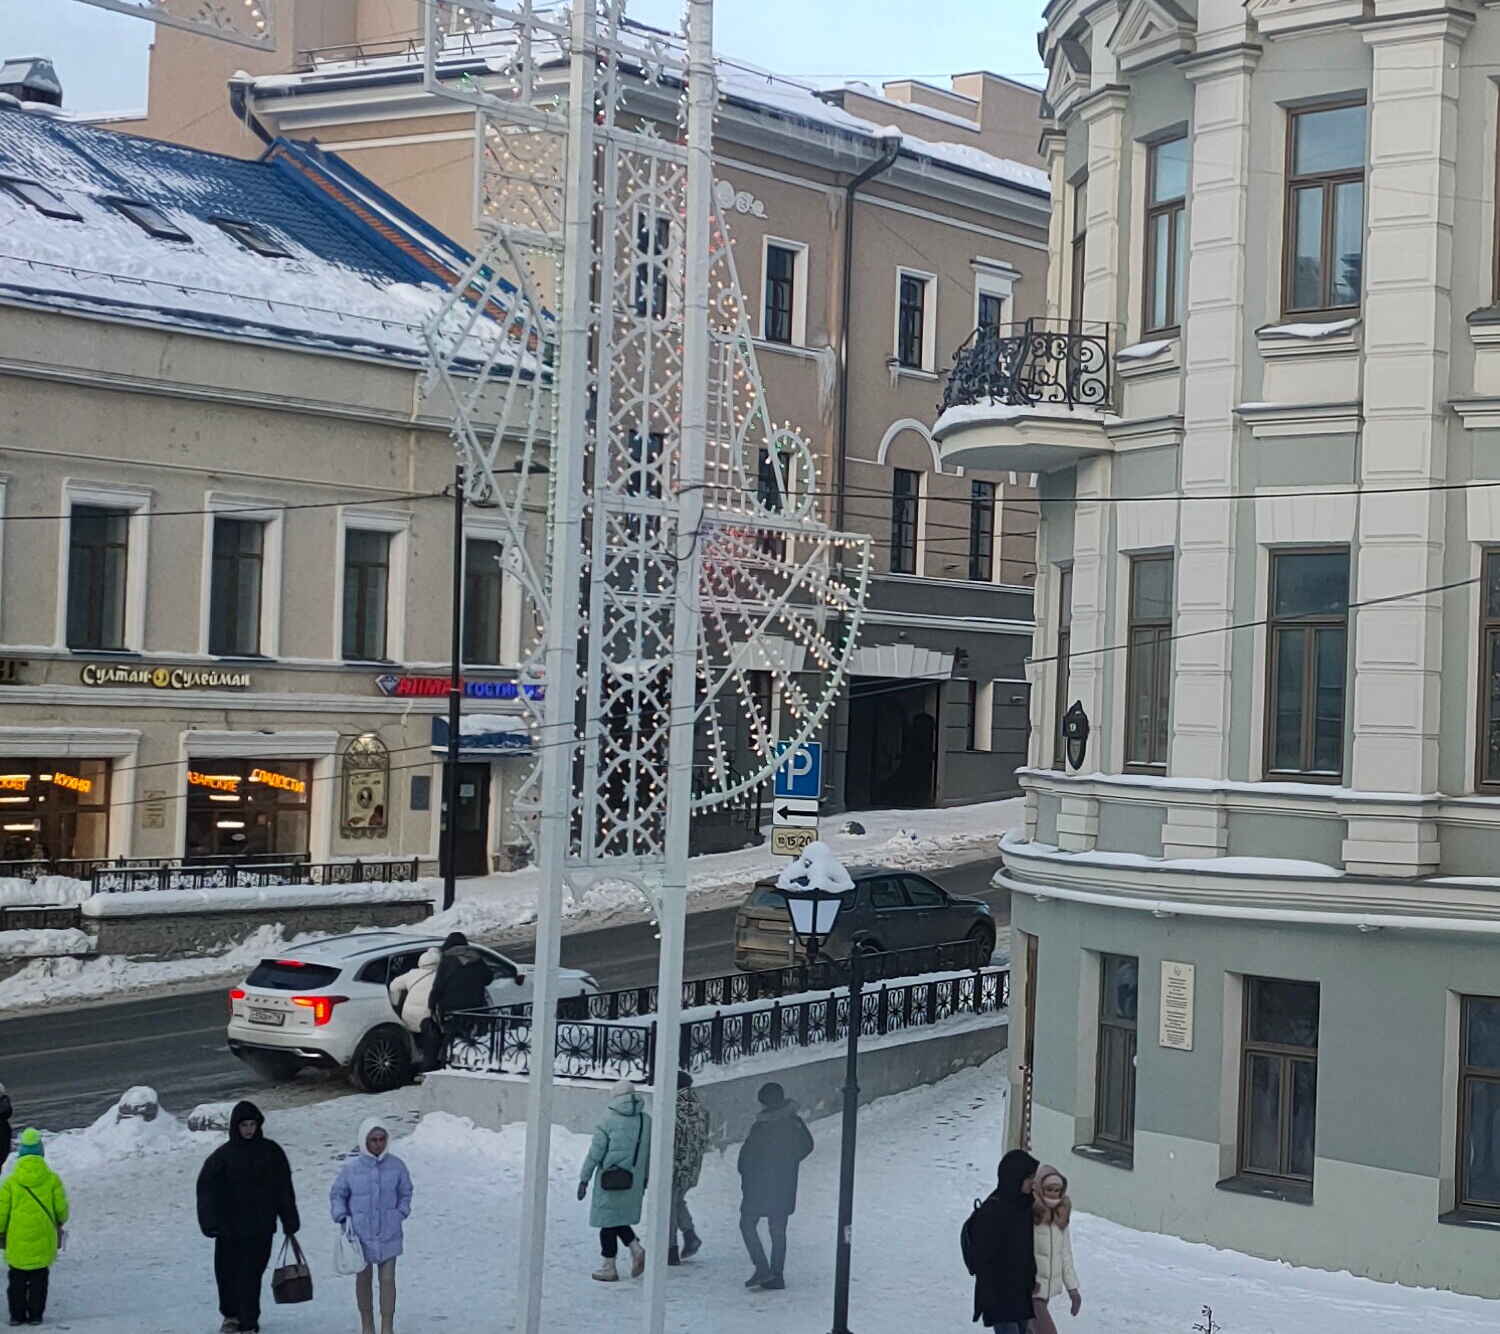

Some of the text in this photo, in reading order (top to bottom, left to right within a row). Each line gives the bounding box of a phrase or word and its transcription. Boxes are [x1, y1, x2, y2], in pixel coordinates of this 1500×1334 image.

[82, 664, 251, 689] Султан Сулейман
[251, 768, 306, 794] СЛАДОСТИ
[786, 747, 813, 791] P
[54, 772, 92, 793] КУХНЯ
[787, 836, 796, 846] 15
[798, 836, 812, 848] 20
